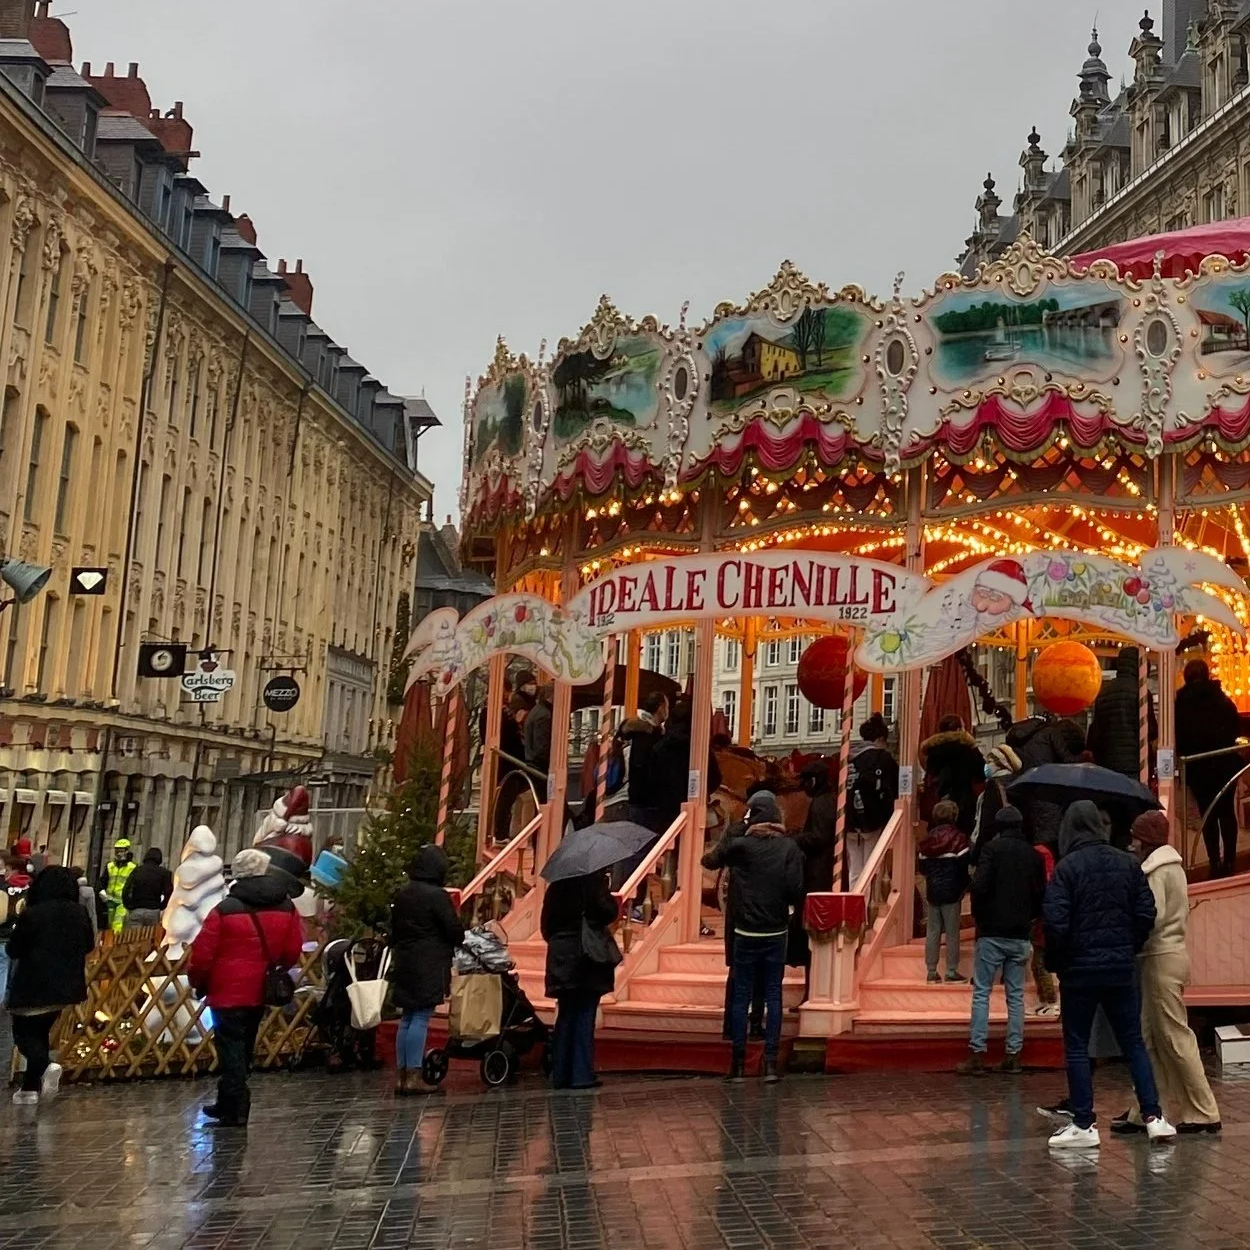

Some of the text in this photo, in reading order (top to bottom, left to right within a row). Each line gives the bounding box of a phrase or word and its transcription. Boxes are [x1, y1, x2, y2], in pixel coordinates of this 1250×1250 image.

[587, 560, 897, 626] IDEALE CHENILLE
[838, 606, 868, 620] 1922
[182, 672, 234, 689] Carlsberg
[193, 690, 220, 700] Beer
[264, 687, 298, 697] MEZZO
